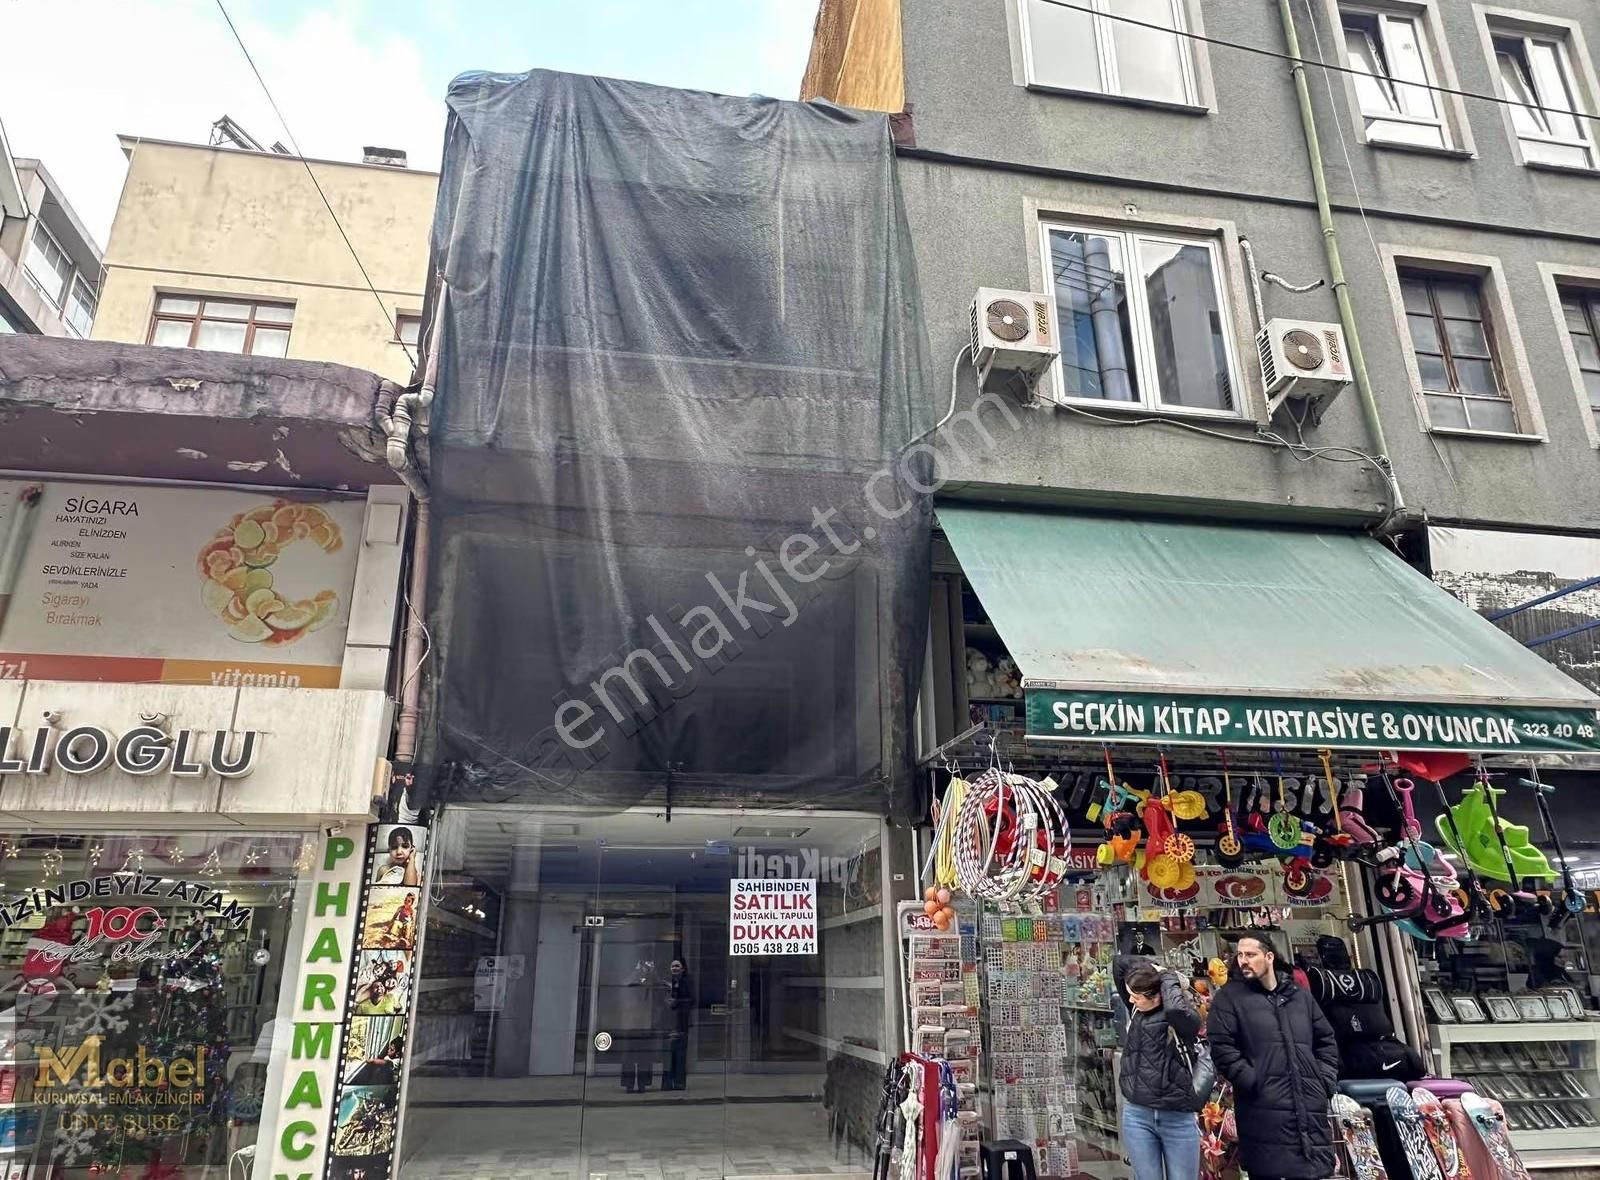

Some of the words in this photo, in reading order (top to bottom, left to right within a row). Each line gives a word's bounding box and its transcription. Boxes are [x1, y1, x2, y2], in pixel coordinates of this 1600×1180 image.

[64, 496, 139, 516] SİGARA
[55, 514, 107, 524] HAYATINIZI
[78, 528, 127, 539] ELİNİZDEN
[42, 564, 127, 578] SEVDİKLERİNİZLE
[41, 591, 90, 609] Sigarayı
[46, 611, 103, 626] Bırakmak
[210, 668, 301, 687] vitamin
[1052, 699, 1145, 734] SEÇKİN
[1153, 701, 1231, 736] KİTAP
[1246, 706, 1378, 740] KIRTASİYE
[1402, 714, 1521, 744] OYUNCAK
[1522, 723, 1549, 737] 323
[1553, 723, 1573, 738] 40
[1577, 723, 1594, 738] 48
[737, 880, 810, 892] SAHİBİNDEN
[168, 880, 254, 929] ATAM
[733, 894, 813, 910] SATILIK
[733, 911, 779, 920] MÜSTAKİL
[781, 911, 814, 920] TAPULU
[733, 921, 814, 940] DÜKKAN
[733, 943, 760, 954] 0505
[763, 943, 783, 953] 438
[786, 943, 799, 953] 28
[802, 942, 815, 953] 41
[276, 836, 355, 1180] PHARMAC
